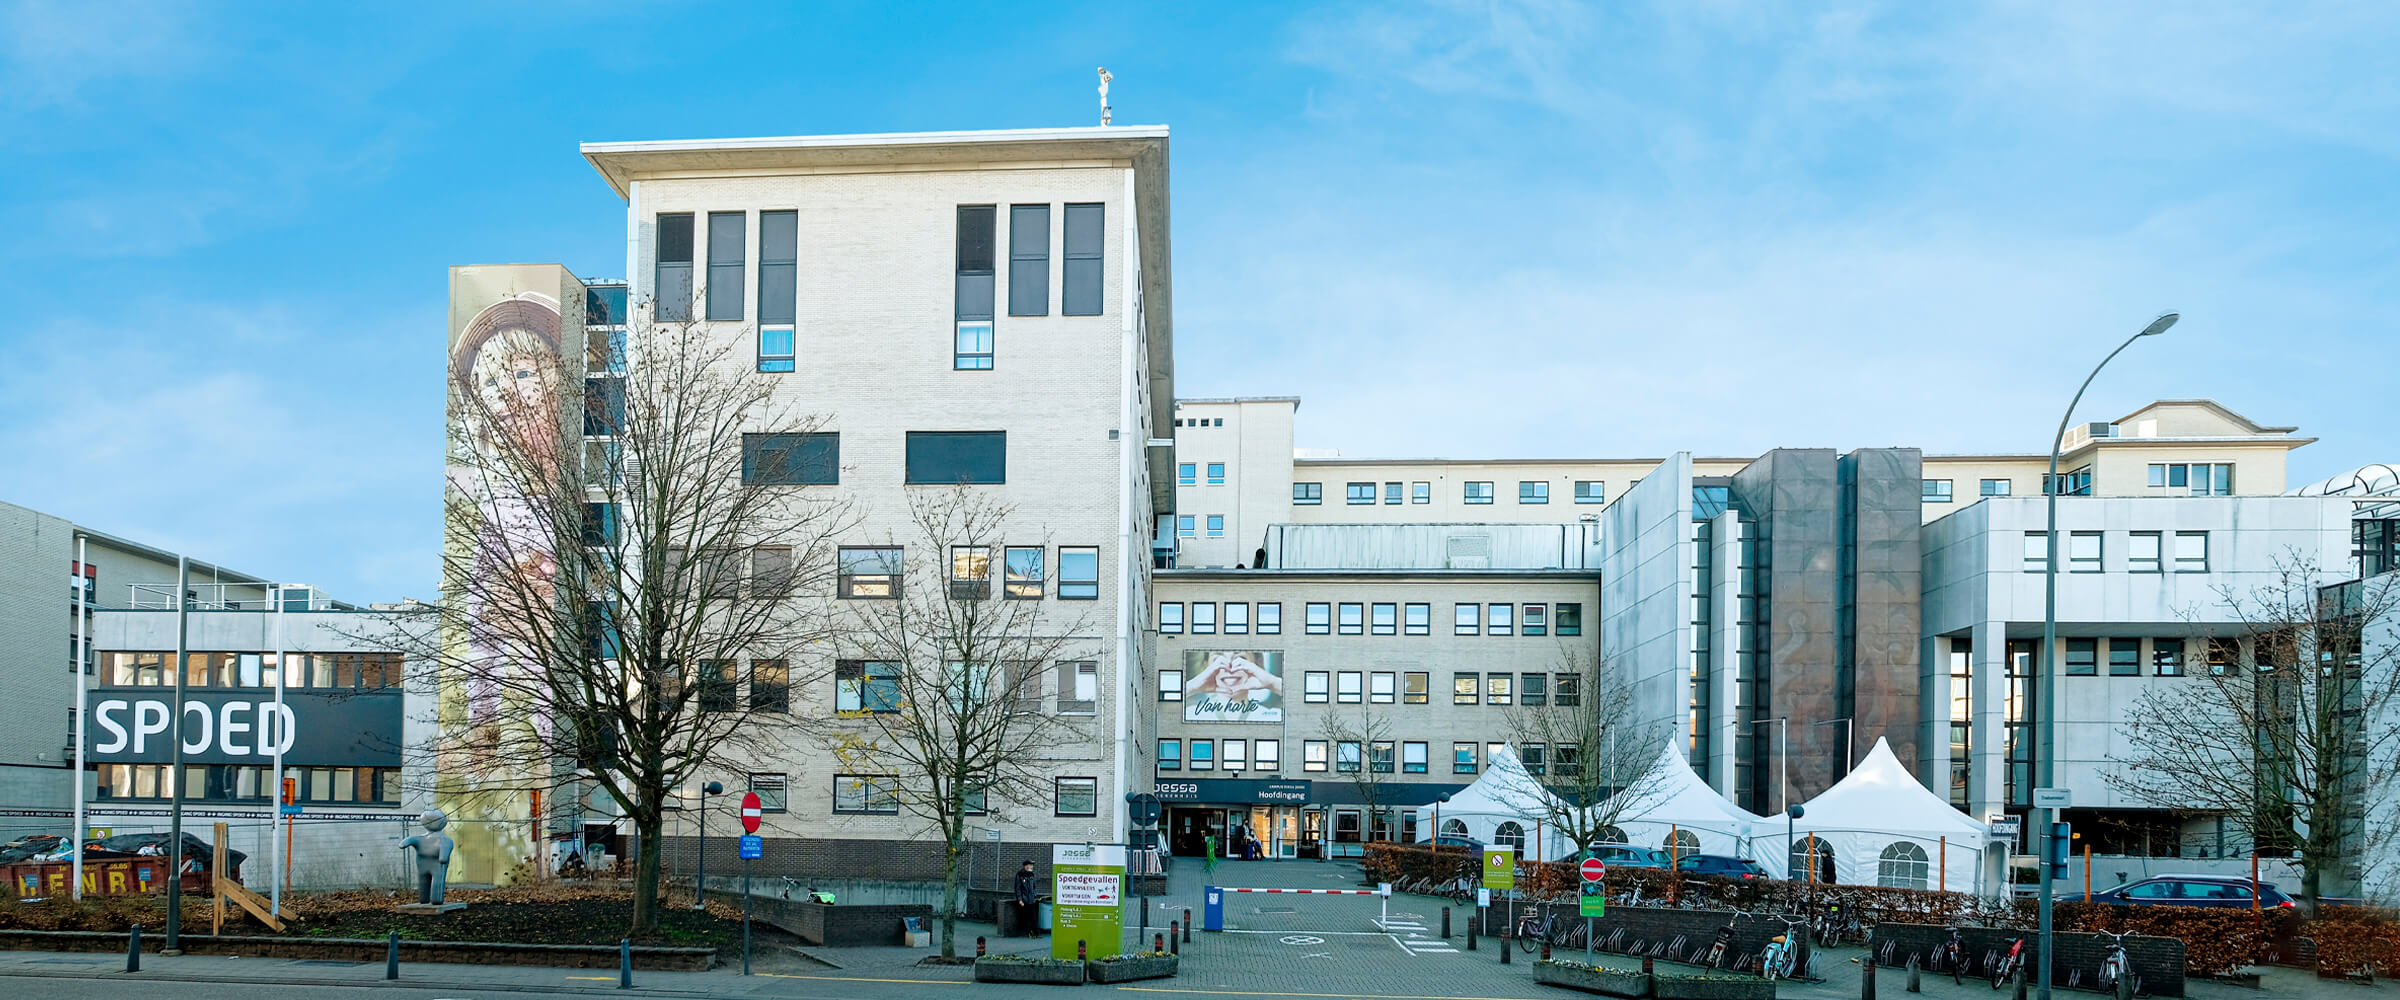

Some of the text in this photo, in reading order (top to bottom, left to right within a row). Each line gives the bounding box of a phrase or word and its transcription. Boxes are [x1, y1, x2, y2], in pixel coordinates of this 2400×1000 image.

[1195, 697, 1259, 715] Van harte
[96, 700, 295, 756] SPOED
[1259, 791, 1305, 800] Hoofdingang
[1058, 874, 1118, 884] Spoedgevallen
